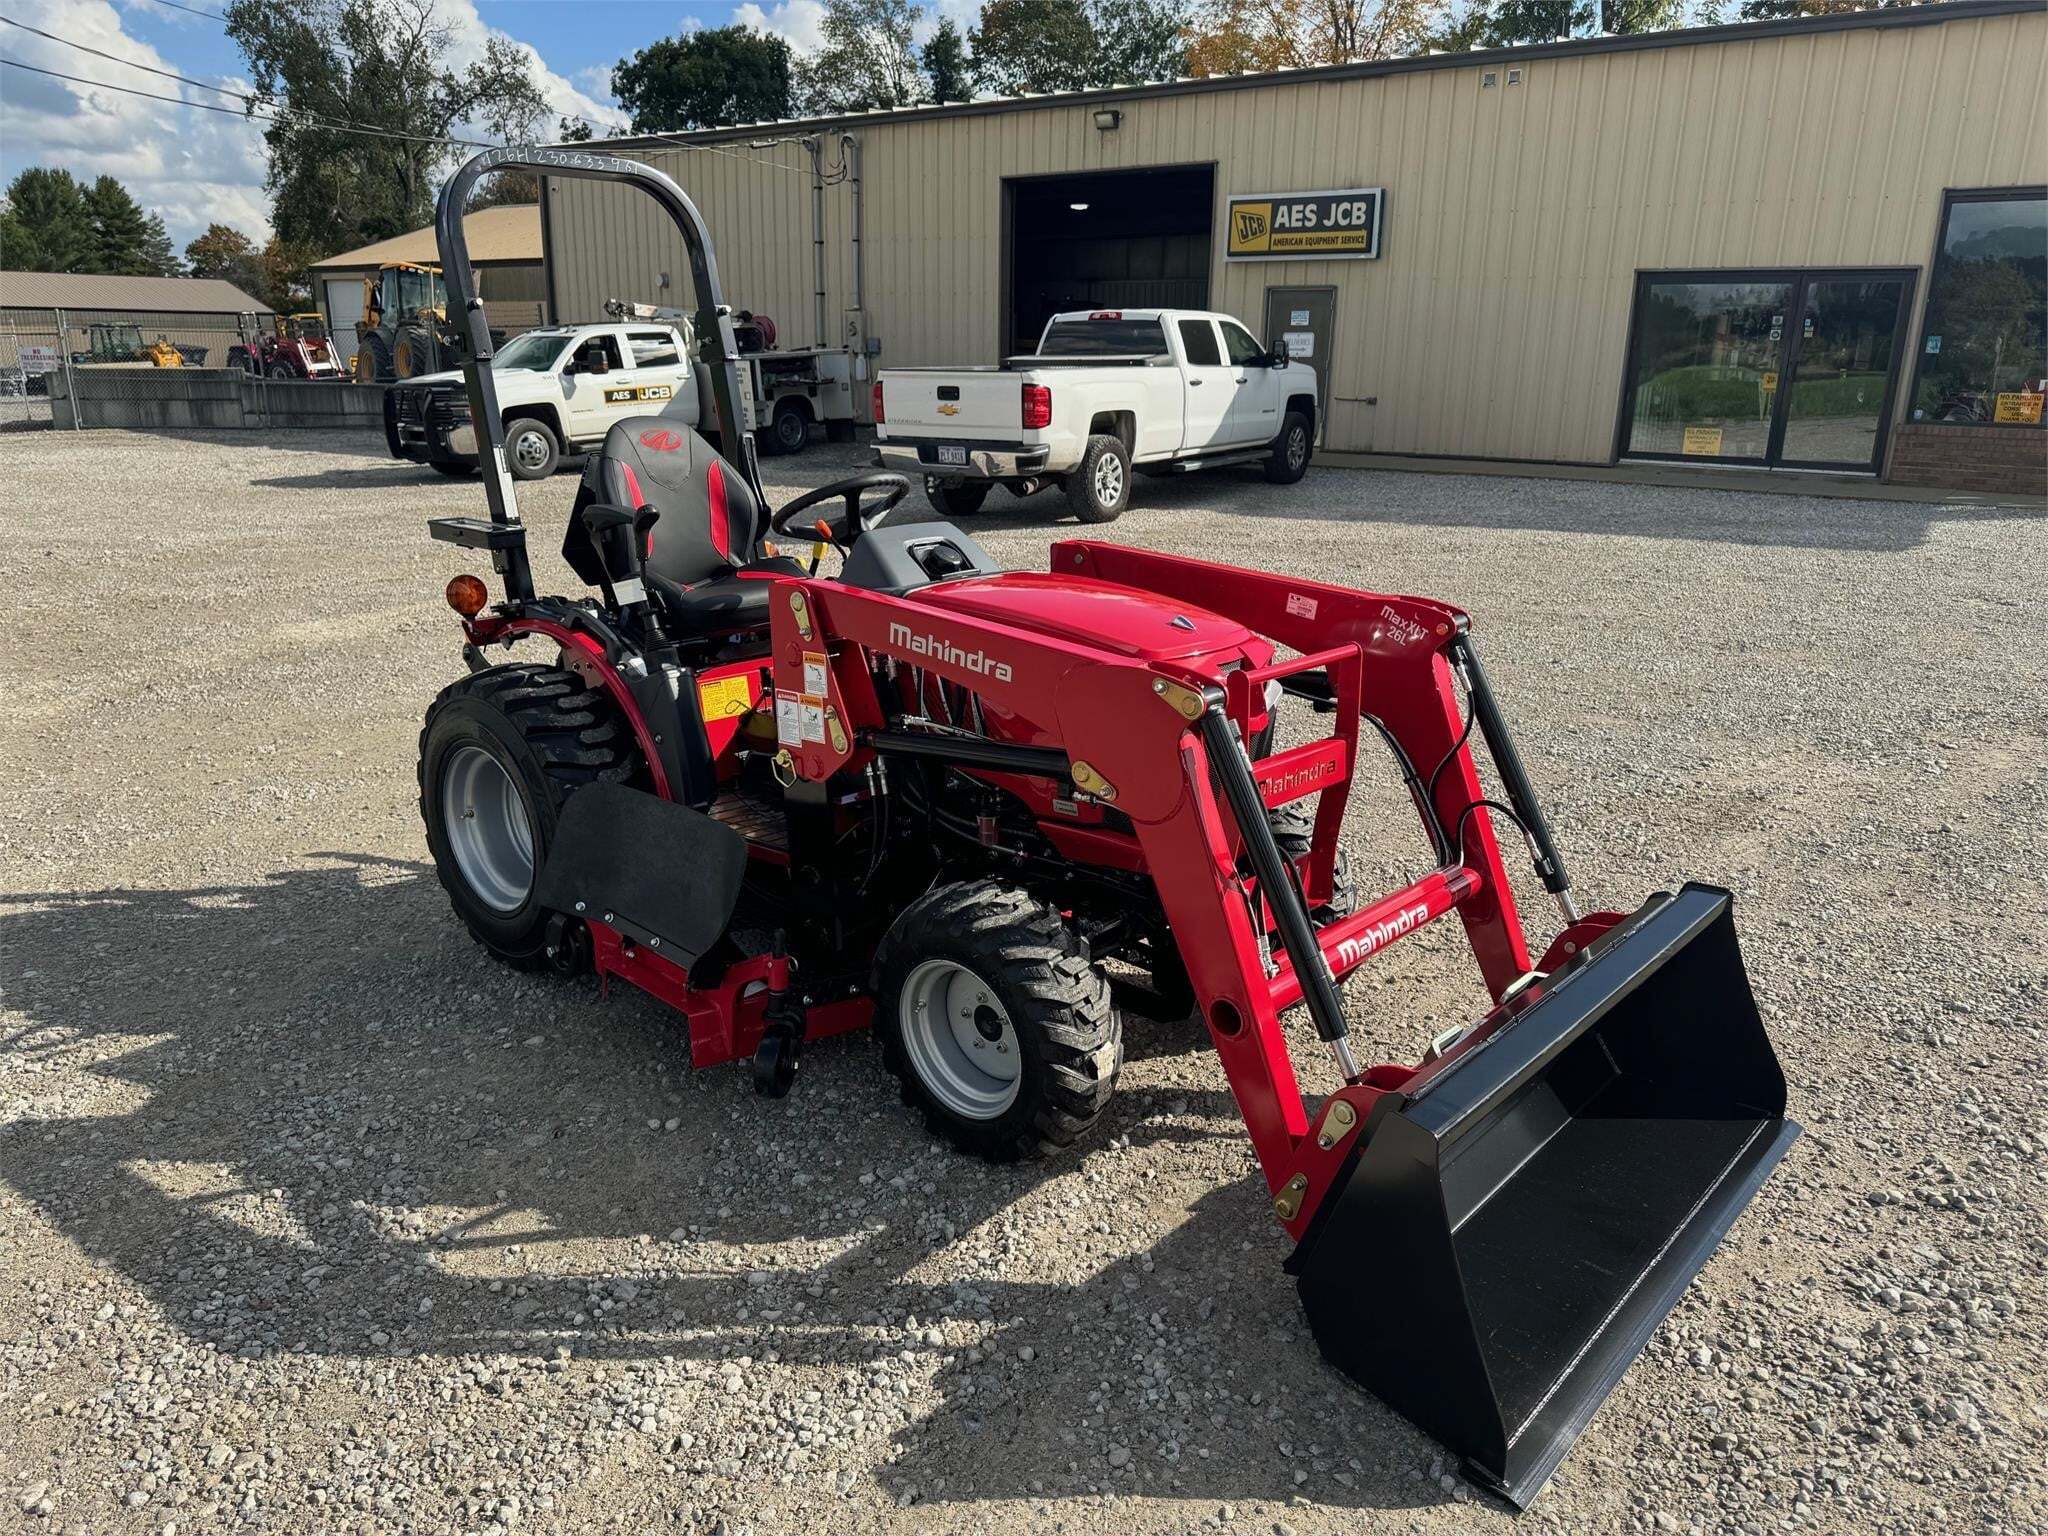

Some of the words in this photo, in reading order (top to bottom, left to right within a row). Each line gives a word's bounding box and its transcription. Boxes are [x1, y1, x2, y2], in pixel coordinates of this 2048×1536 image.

[1240, 214, 1265, 240] JCB
[1274, 204, 1317, 228] AES
[1323, 202, 1367, 227] JCB
[1272, 236, 1303, 247] AMERICAN
[1305, 236, 1339, 246] EQUIPMENT
[1341, 234, 1365, 245] SERVICE
[612, 390, 630, 400] AES
[640, 387, 671, 399] JCB
[1387, 626, 1408, 647] 26L
[889, 622, 1013, 683] Mahindra
[1259, 760, 1337, 797] Mahindra
[1336, 903, 1429, 968] Mahindra
